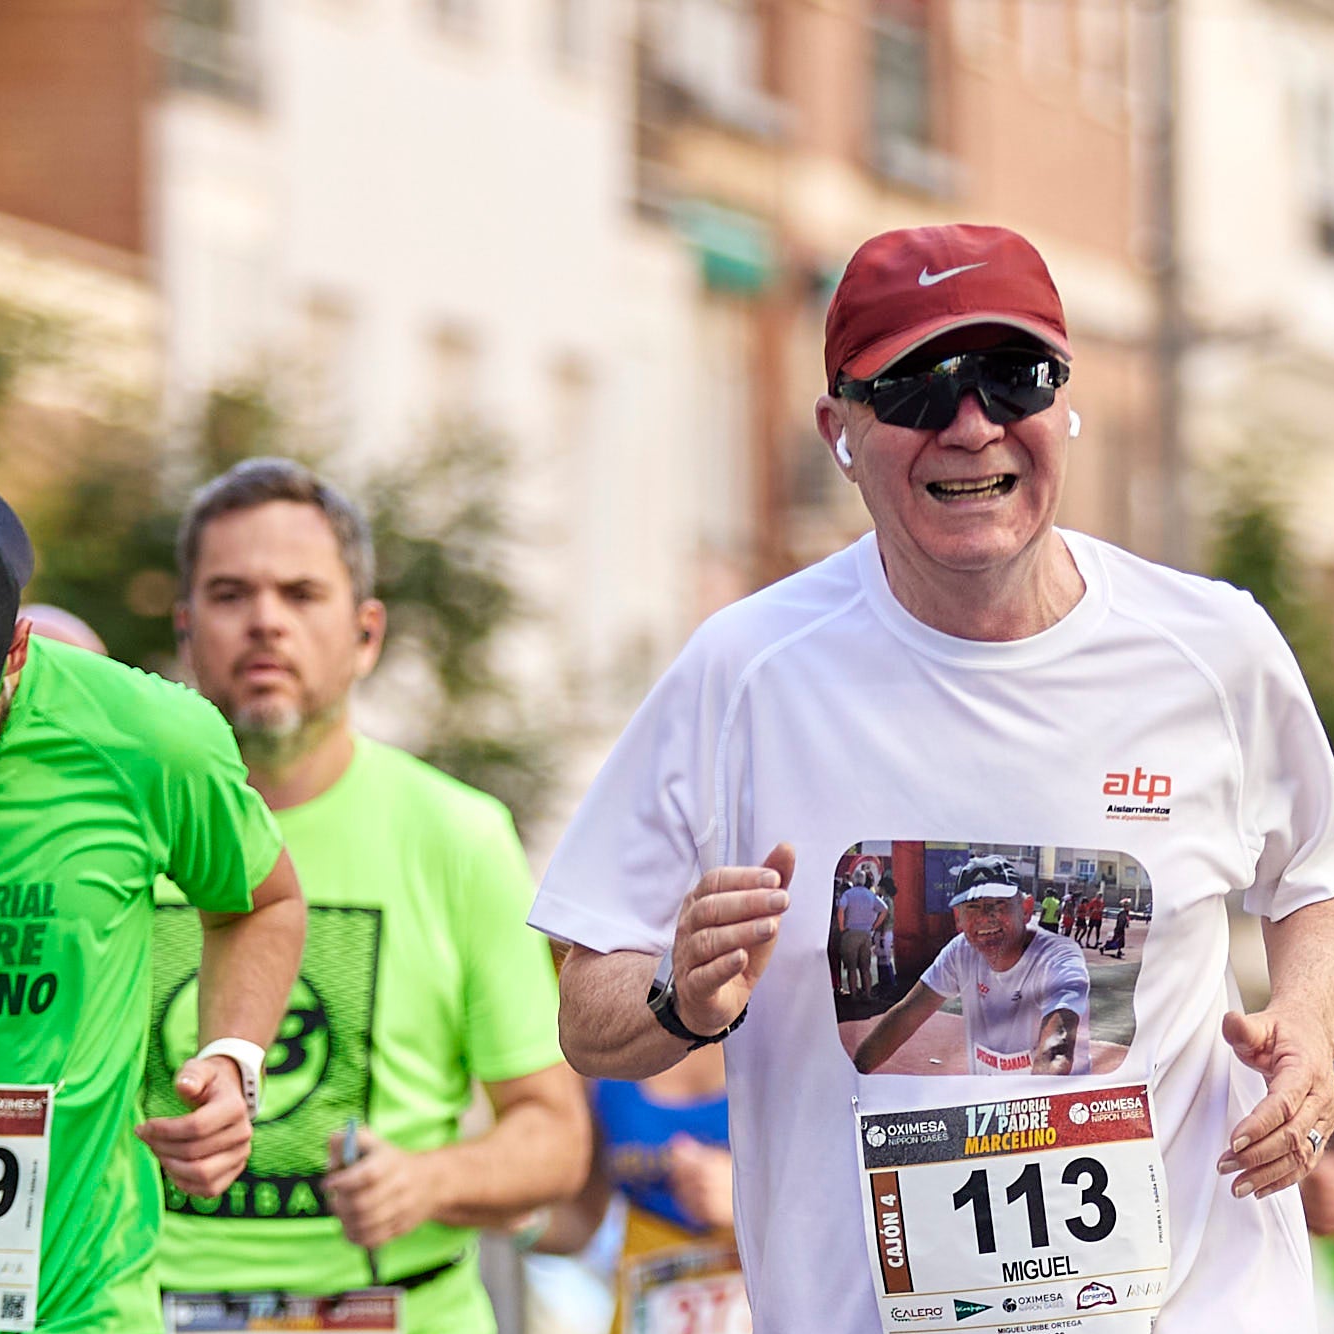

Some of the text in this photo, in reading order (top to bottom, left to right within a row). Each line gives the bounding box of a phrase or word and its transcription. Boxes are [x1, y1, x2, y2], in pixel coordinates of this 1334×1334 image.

[1103, 766, 1171, 803] atp
[995, 1098, 1051, 1117] MEMORIAL
[1090, 1097, 1143, 1113] OXIMESA
[966, 1104, 995, 1137] 17
[998, 1111, 1048, 1134] PADRE
[1091, 1111, 1120, 1123] NIPPON
[887, 1120, 947, 1136] OXIMESA
[889, 1132, 949, 1146] NIPPON GASES
[965, 1127, 1057, 1155] MARCELINO
[952, 1156, 1117, 1254] 113
[879, 1193, 904, 1268] CAJÓN 4
[1002, 1255, 1079, 1283] MIGUEL
[1018, 1293, 1063, 1305] OXIMESA
[891, 1306, 943, 1321] CALERO
[997, 1320, 1082, 1334] MIGUEL URIBE ORTEGA
